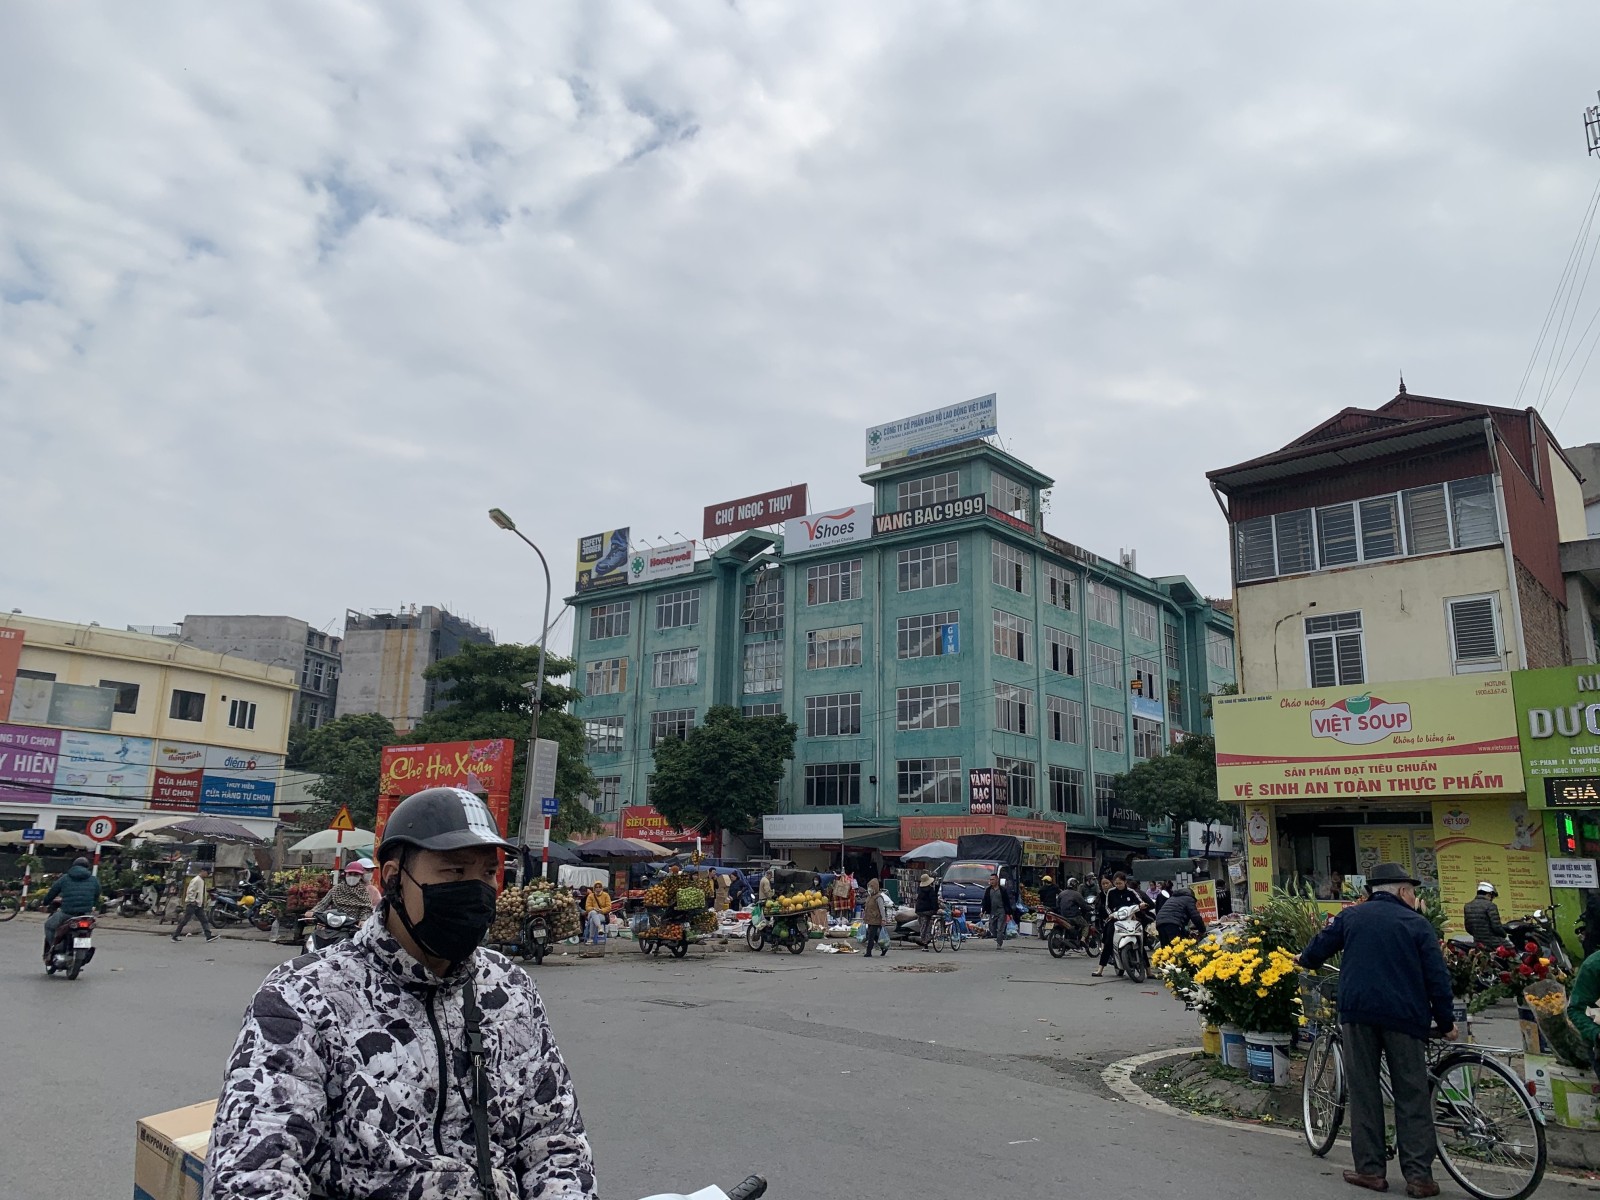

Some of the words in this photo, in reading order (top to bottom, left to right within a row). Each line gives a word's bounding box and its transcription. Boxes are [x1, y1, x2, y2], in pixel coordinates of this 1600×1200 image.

[883, 424, 897, 436] CÔNG
[897, 423, 903, 432] TY
[943, 409, 953, 420] LAO
[980, 399, 993, 410] NAM
[715, 505, 735, 526] CHỢ
[737, 500, 764, 521] NGỌC
[768, 493, 793, 515] THỤY
[876, 511, 912, 533] VÀNG
[914, 506, 943, 525] BẠC
[945, 497, 983, 519] 9999
[650, 550, 692, 567] Honeywell
[947, 626, 955, 654] GYM
[1484, 680, 1507, 688] HOTLINE
[1280, 697, 1302, 708] Cháo
[1304, 697, 1326, 708] nóng
[1314, 714, 1352, 737] VIỆT
[1357, 713, 1408, 731] SOUP
[1392, 734, 1415, 744] Không
[1416, 734, 1424, 743] lo
[389, 756, 424, 780] Chợ
[425, 753, 452, 780] Hoa
[453, 752, 493, 778] Xuân
[1284, 767, 1306, 777] SẢN
[1309, 765, 1341, 776] PHẨM
[1344, 766, 1365, 777] ĐẠT
[1368, 764, 1393, 774] TIÊU
[1396, 760, 1437, 773] CHUẨN
[970, 770, 991, 786] VÀNG
[1234, 782, 1254, 799] VỆ
[1259, 783, 1299, 796] SINH
[1305, 782, 1329, 795] AN
[1334, 777, 1382, 794] TOÀN
[1387, 776, 1437, 794] THỰC
[1442, 770, 1504, 790] PHẨM
[972, 787, 990, 803] BẠC
[971, 803, 992, 814] 9999
[625, 815, 645, 827] SIÊU
[1455, 817, 1470, 825] SOUP
